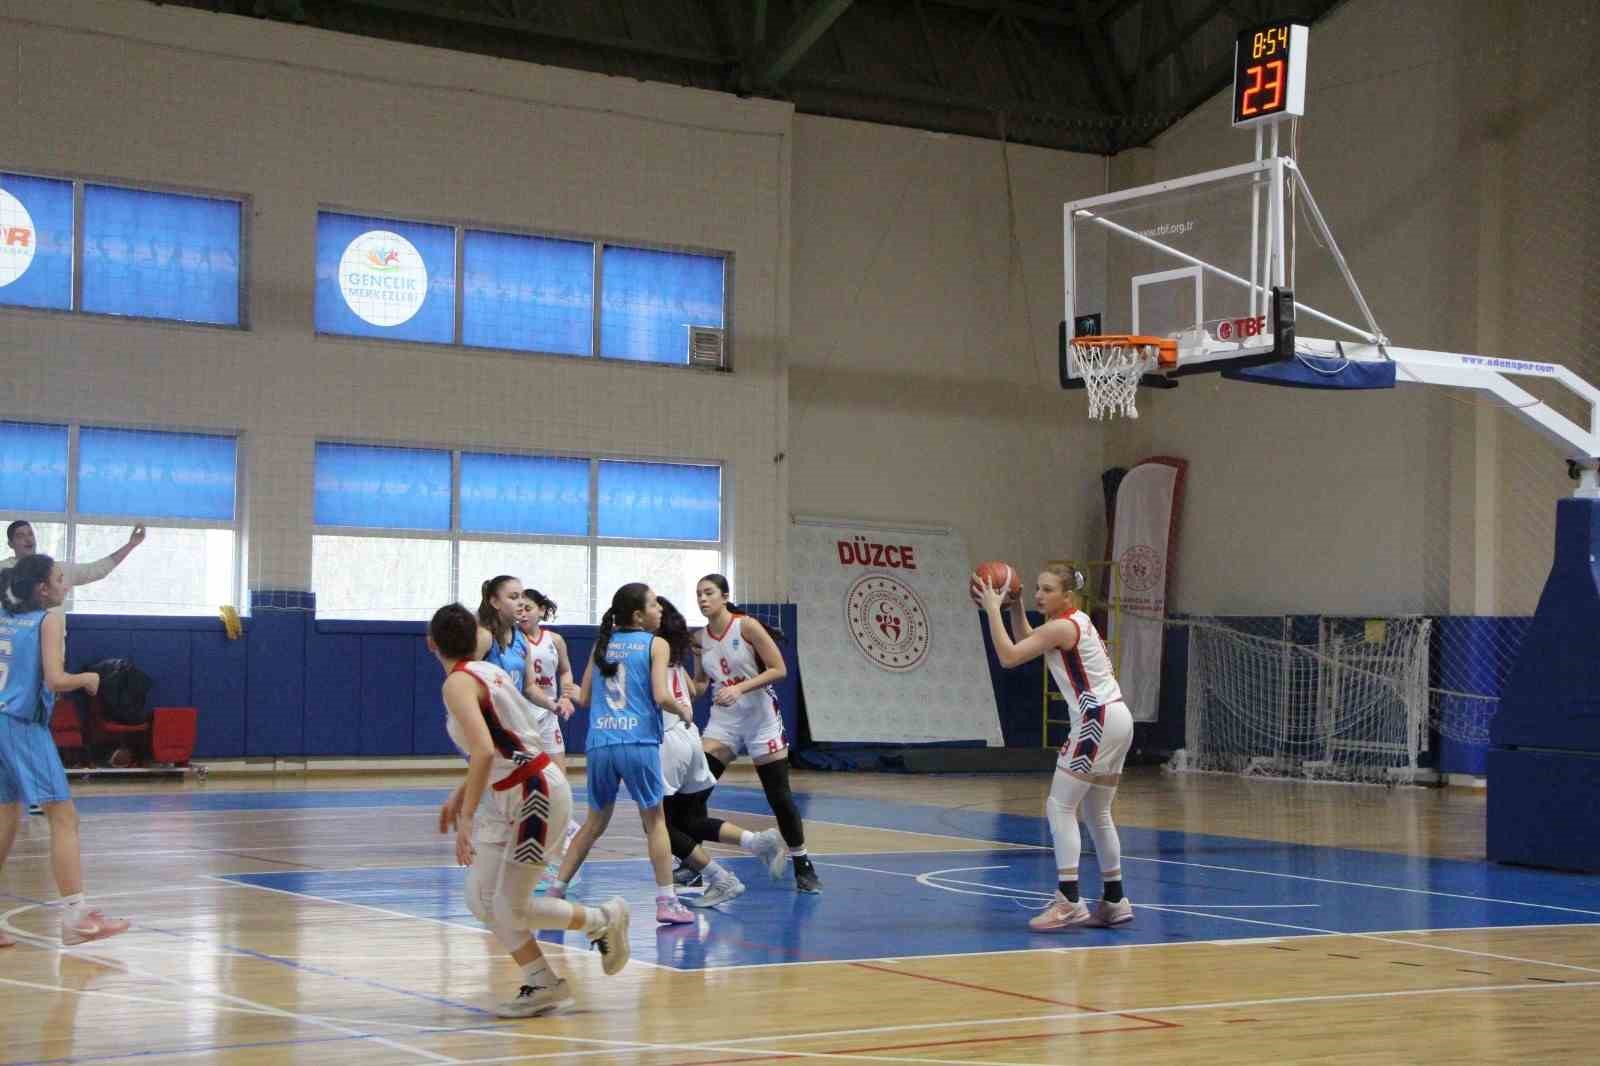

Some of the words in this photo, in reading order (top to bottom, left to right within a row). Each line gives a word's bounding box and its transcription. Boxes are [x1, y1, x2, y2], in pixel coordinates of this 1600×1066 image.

[1252, 26, 1288, 59] 8:54
[1242, 59, 1284, 115] 23
[1233, 315, 1265, 337] TBF
[837, 535, 917, 570] DÜZCE
[533, 658, 543, 674] 6
[720, 656, 731, 676] 8
[595, 714, 638, 731] SİNOP
